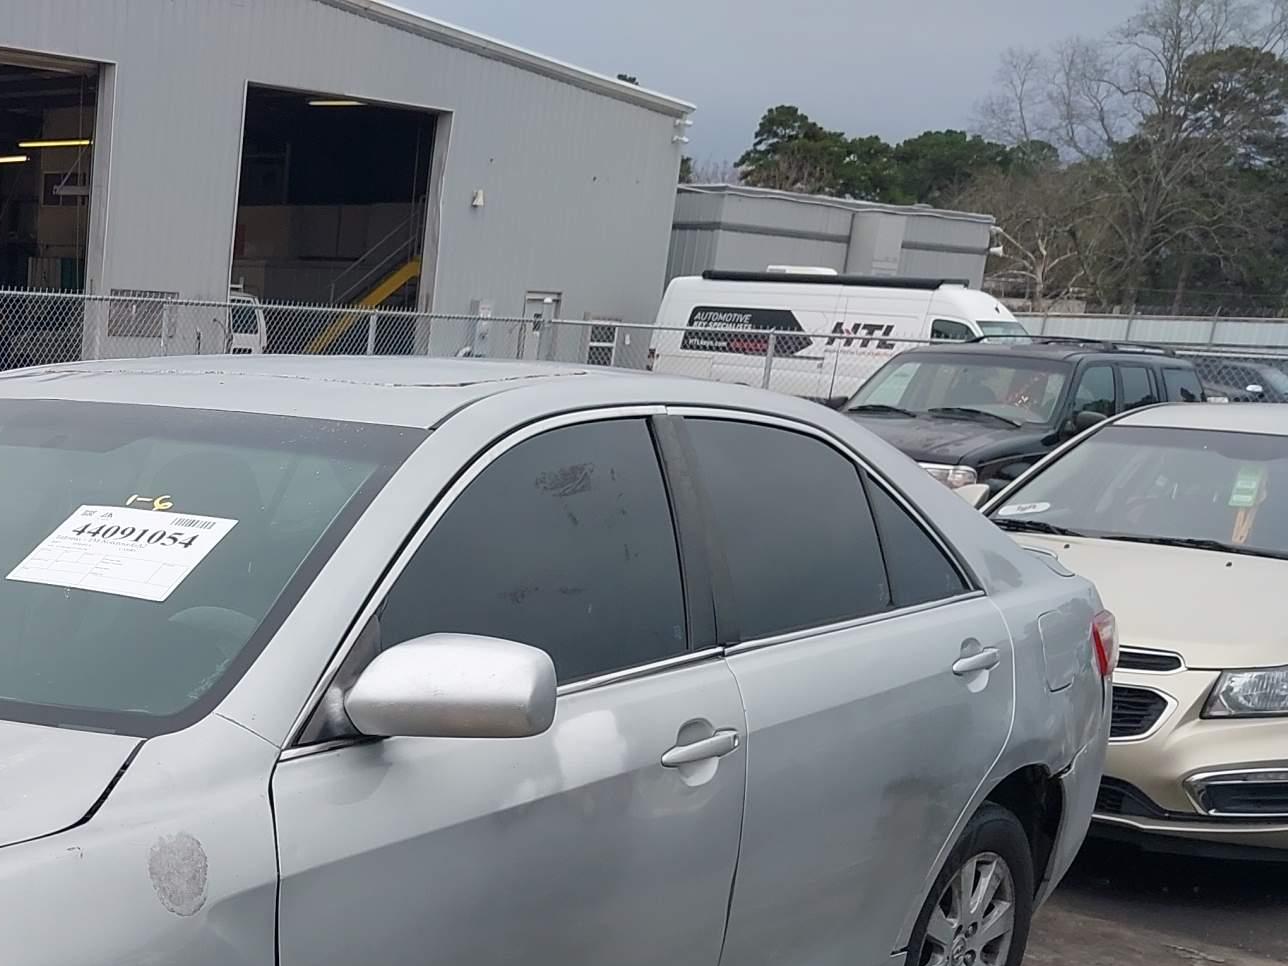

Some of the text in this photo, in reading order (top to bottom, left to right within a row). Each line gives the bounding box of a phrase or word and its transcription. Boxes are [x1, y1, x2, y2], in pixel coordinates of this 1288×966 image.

[694, 312, 752, 323] AUTOMOTIVE
[825, 322, 895, 349] HTL
[72, 523, 199, 549] 44091054
